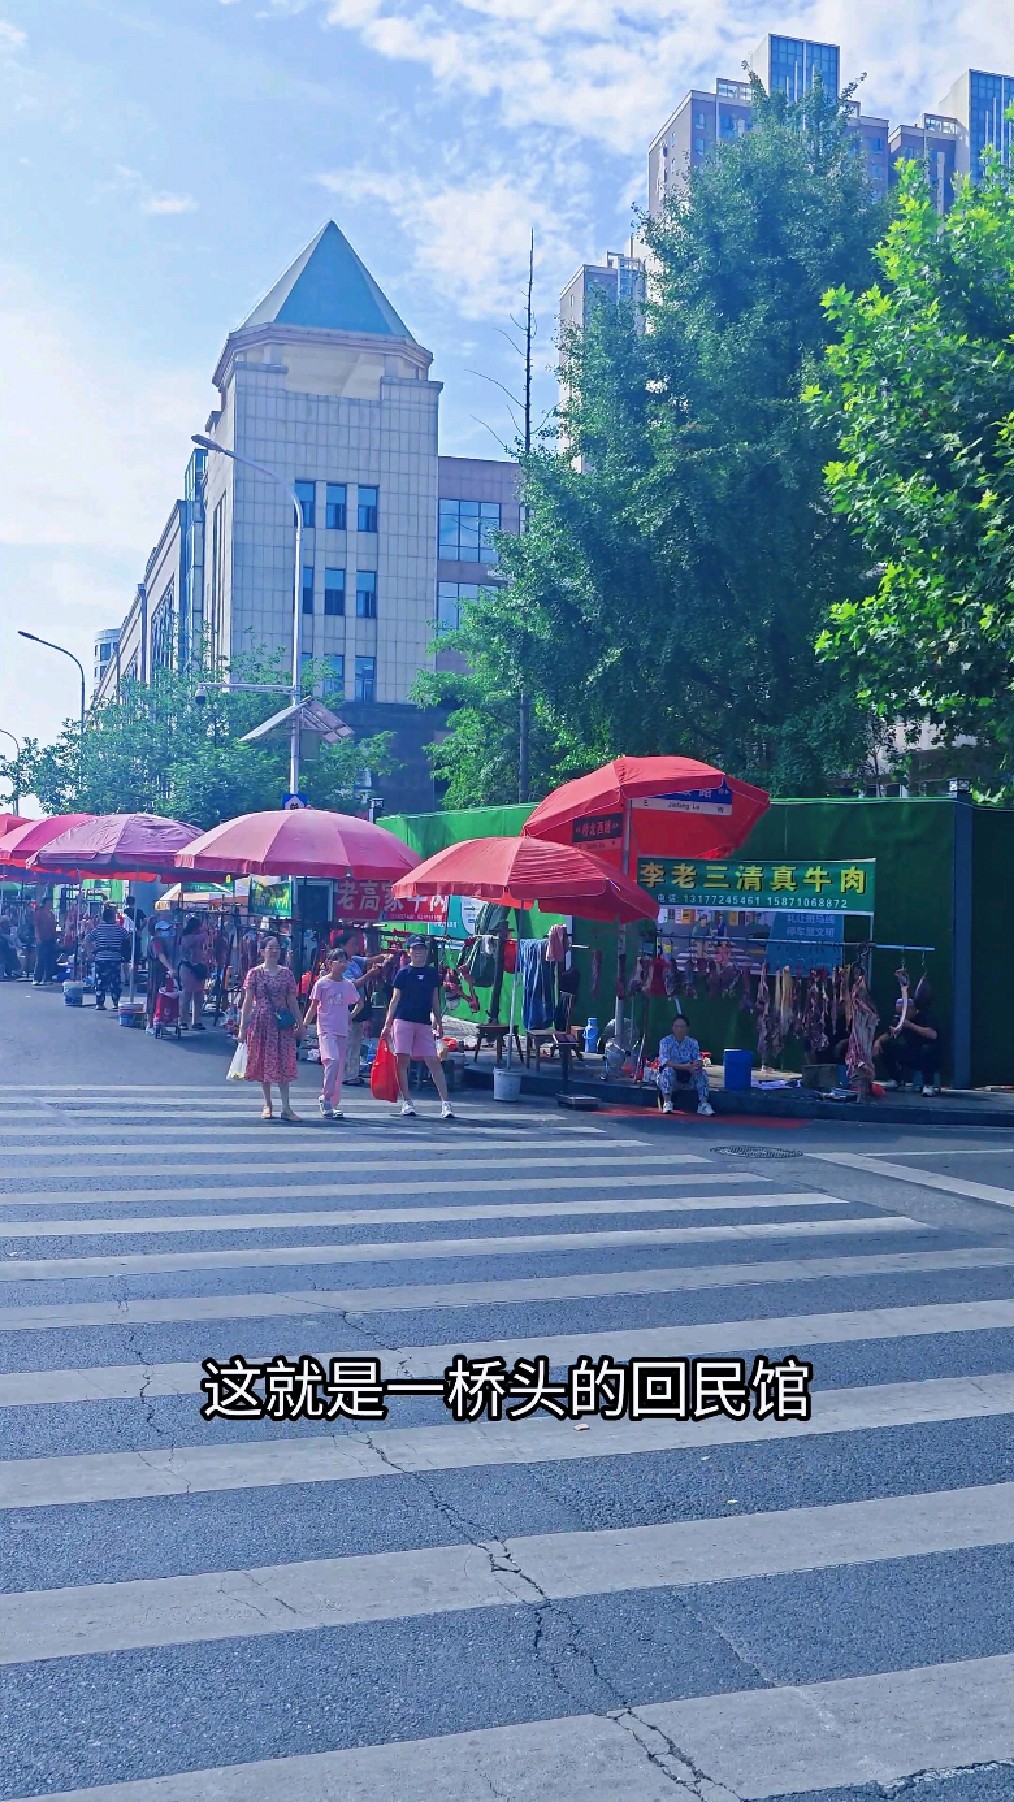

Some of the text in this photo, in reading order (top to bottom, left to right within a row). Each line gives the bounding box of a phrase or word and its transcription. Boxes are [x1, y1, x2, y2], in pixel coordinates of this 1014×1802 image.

[639, 862, 867, 894] 李老三清真牛肉
[683, 893, 760, 906] 13177245461
